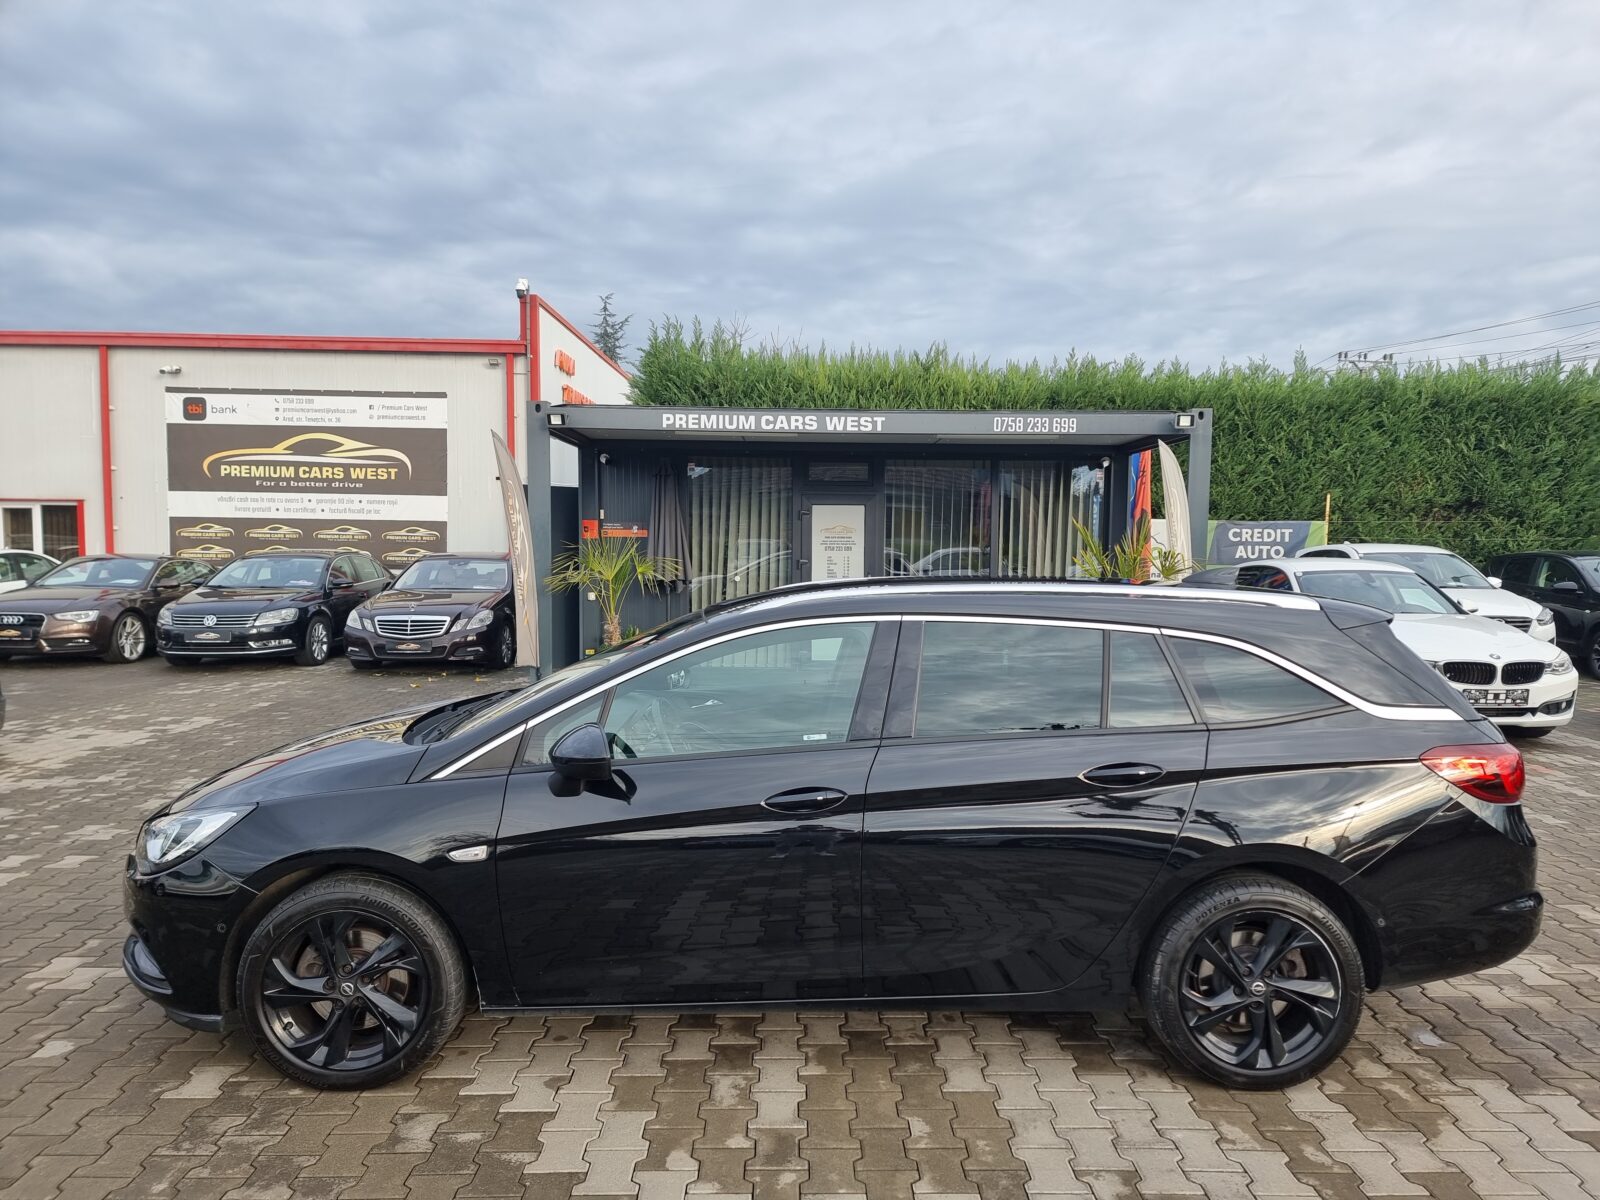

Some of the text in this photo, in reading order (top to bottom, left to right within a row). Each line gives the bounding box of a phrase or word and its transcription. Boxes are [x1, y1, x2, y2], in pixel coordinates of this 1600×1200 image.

[187, 403, 203, 414] tbi
[211, 404, 238, 414] bank
[662, 413, 886, 432] PREMIUM CARS WEST
[993, 417, 1077, 433] 0758 233 699
[220, 464, 398, 481] PREMIUM CARS WEST
[290, 480, 329, 488] better
[331, 481, 364, 489] drive
[1228, 528, 1294, 543] CREDIT
[1235, 545, 1285, 559] AUTO
[1195, 896, 1241, 924] POTENZA
